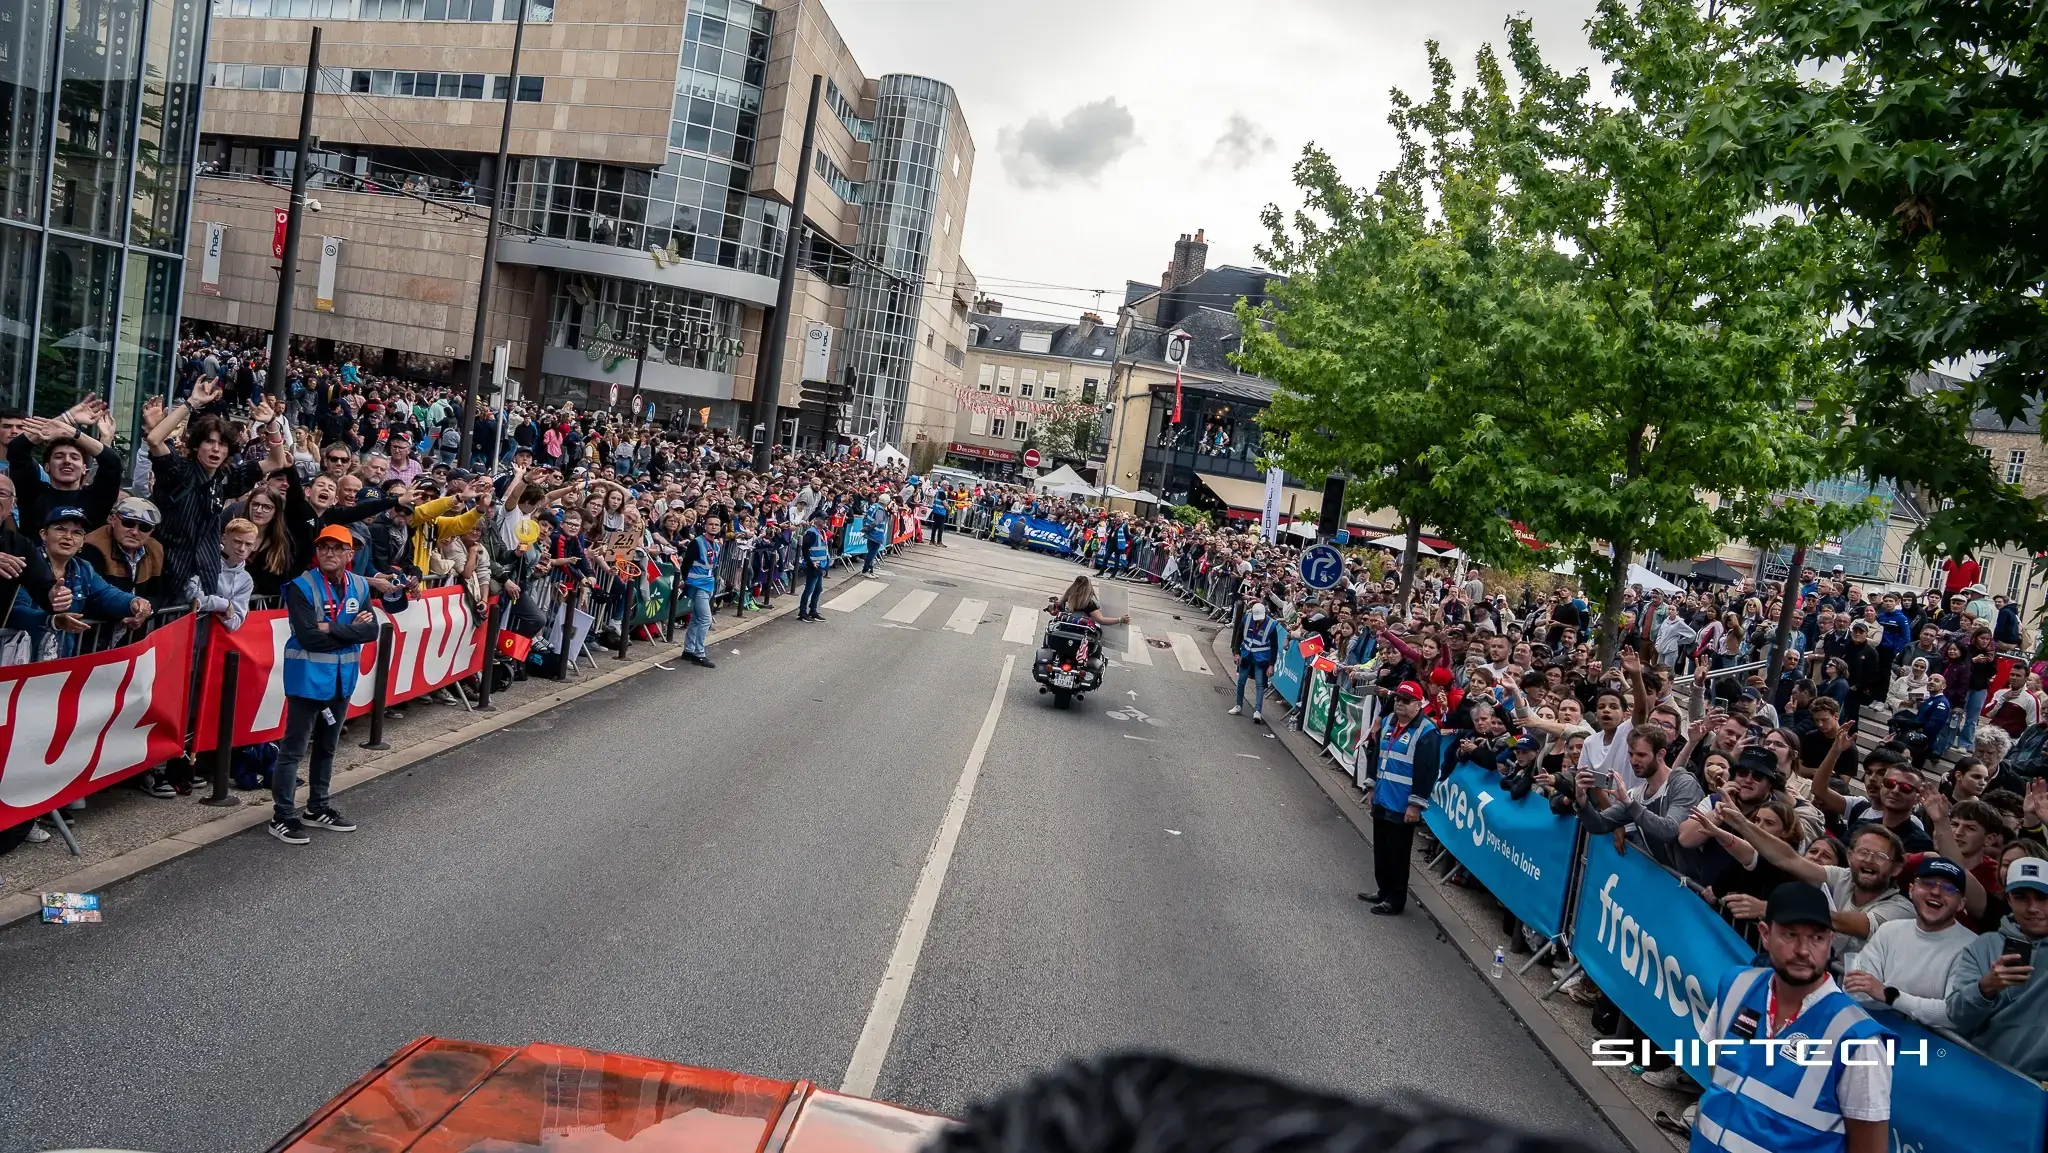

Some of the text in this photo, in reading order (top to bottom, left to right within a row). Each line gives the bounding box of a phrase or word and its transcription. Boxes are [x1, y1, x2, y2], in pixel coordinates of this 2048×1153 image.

[210, 229, 220, 257] fnac
[0, 646, 157, 808] UL
[1486, 830, 1541, 880] pays de la loire
[1597, 873, 1712, 1038] france
